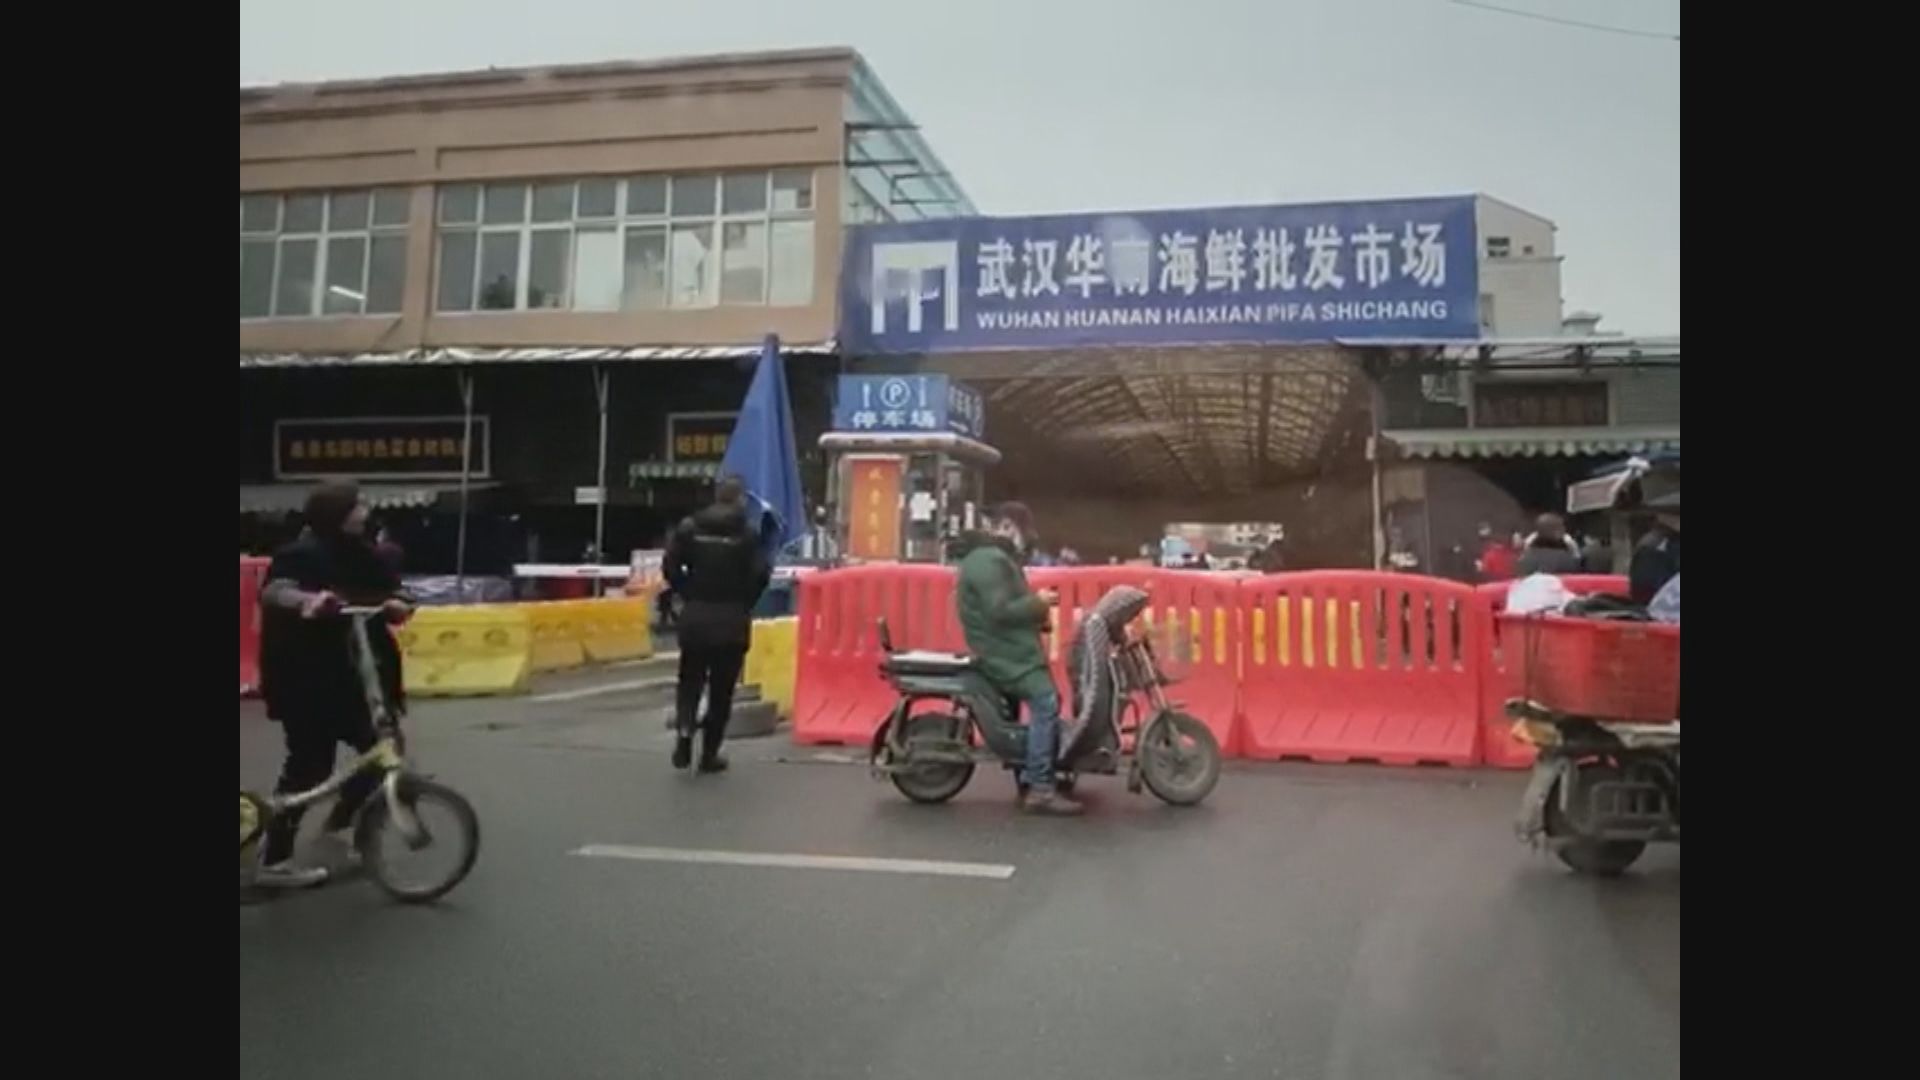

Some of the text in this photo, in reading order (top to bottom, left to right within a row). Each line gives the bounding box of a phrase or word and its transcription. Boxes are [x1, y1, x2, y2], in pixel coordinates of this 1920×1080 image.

[976, 299, 1448, 330] WUHAN HUANAN HAIXIAN PIFA SHICHANG
[852, 409, 937, 429] 停车场
